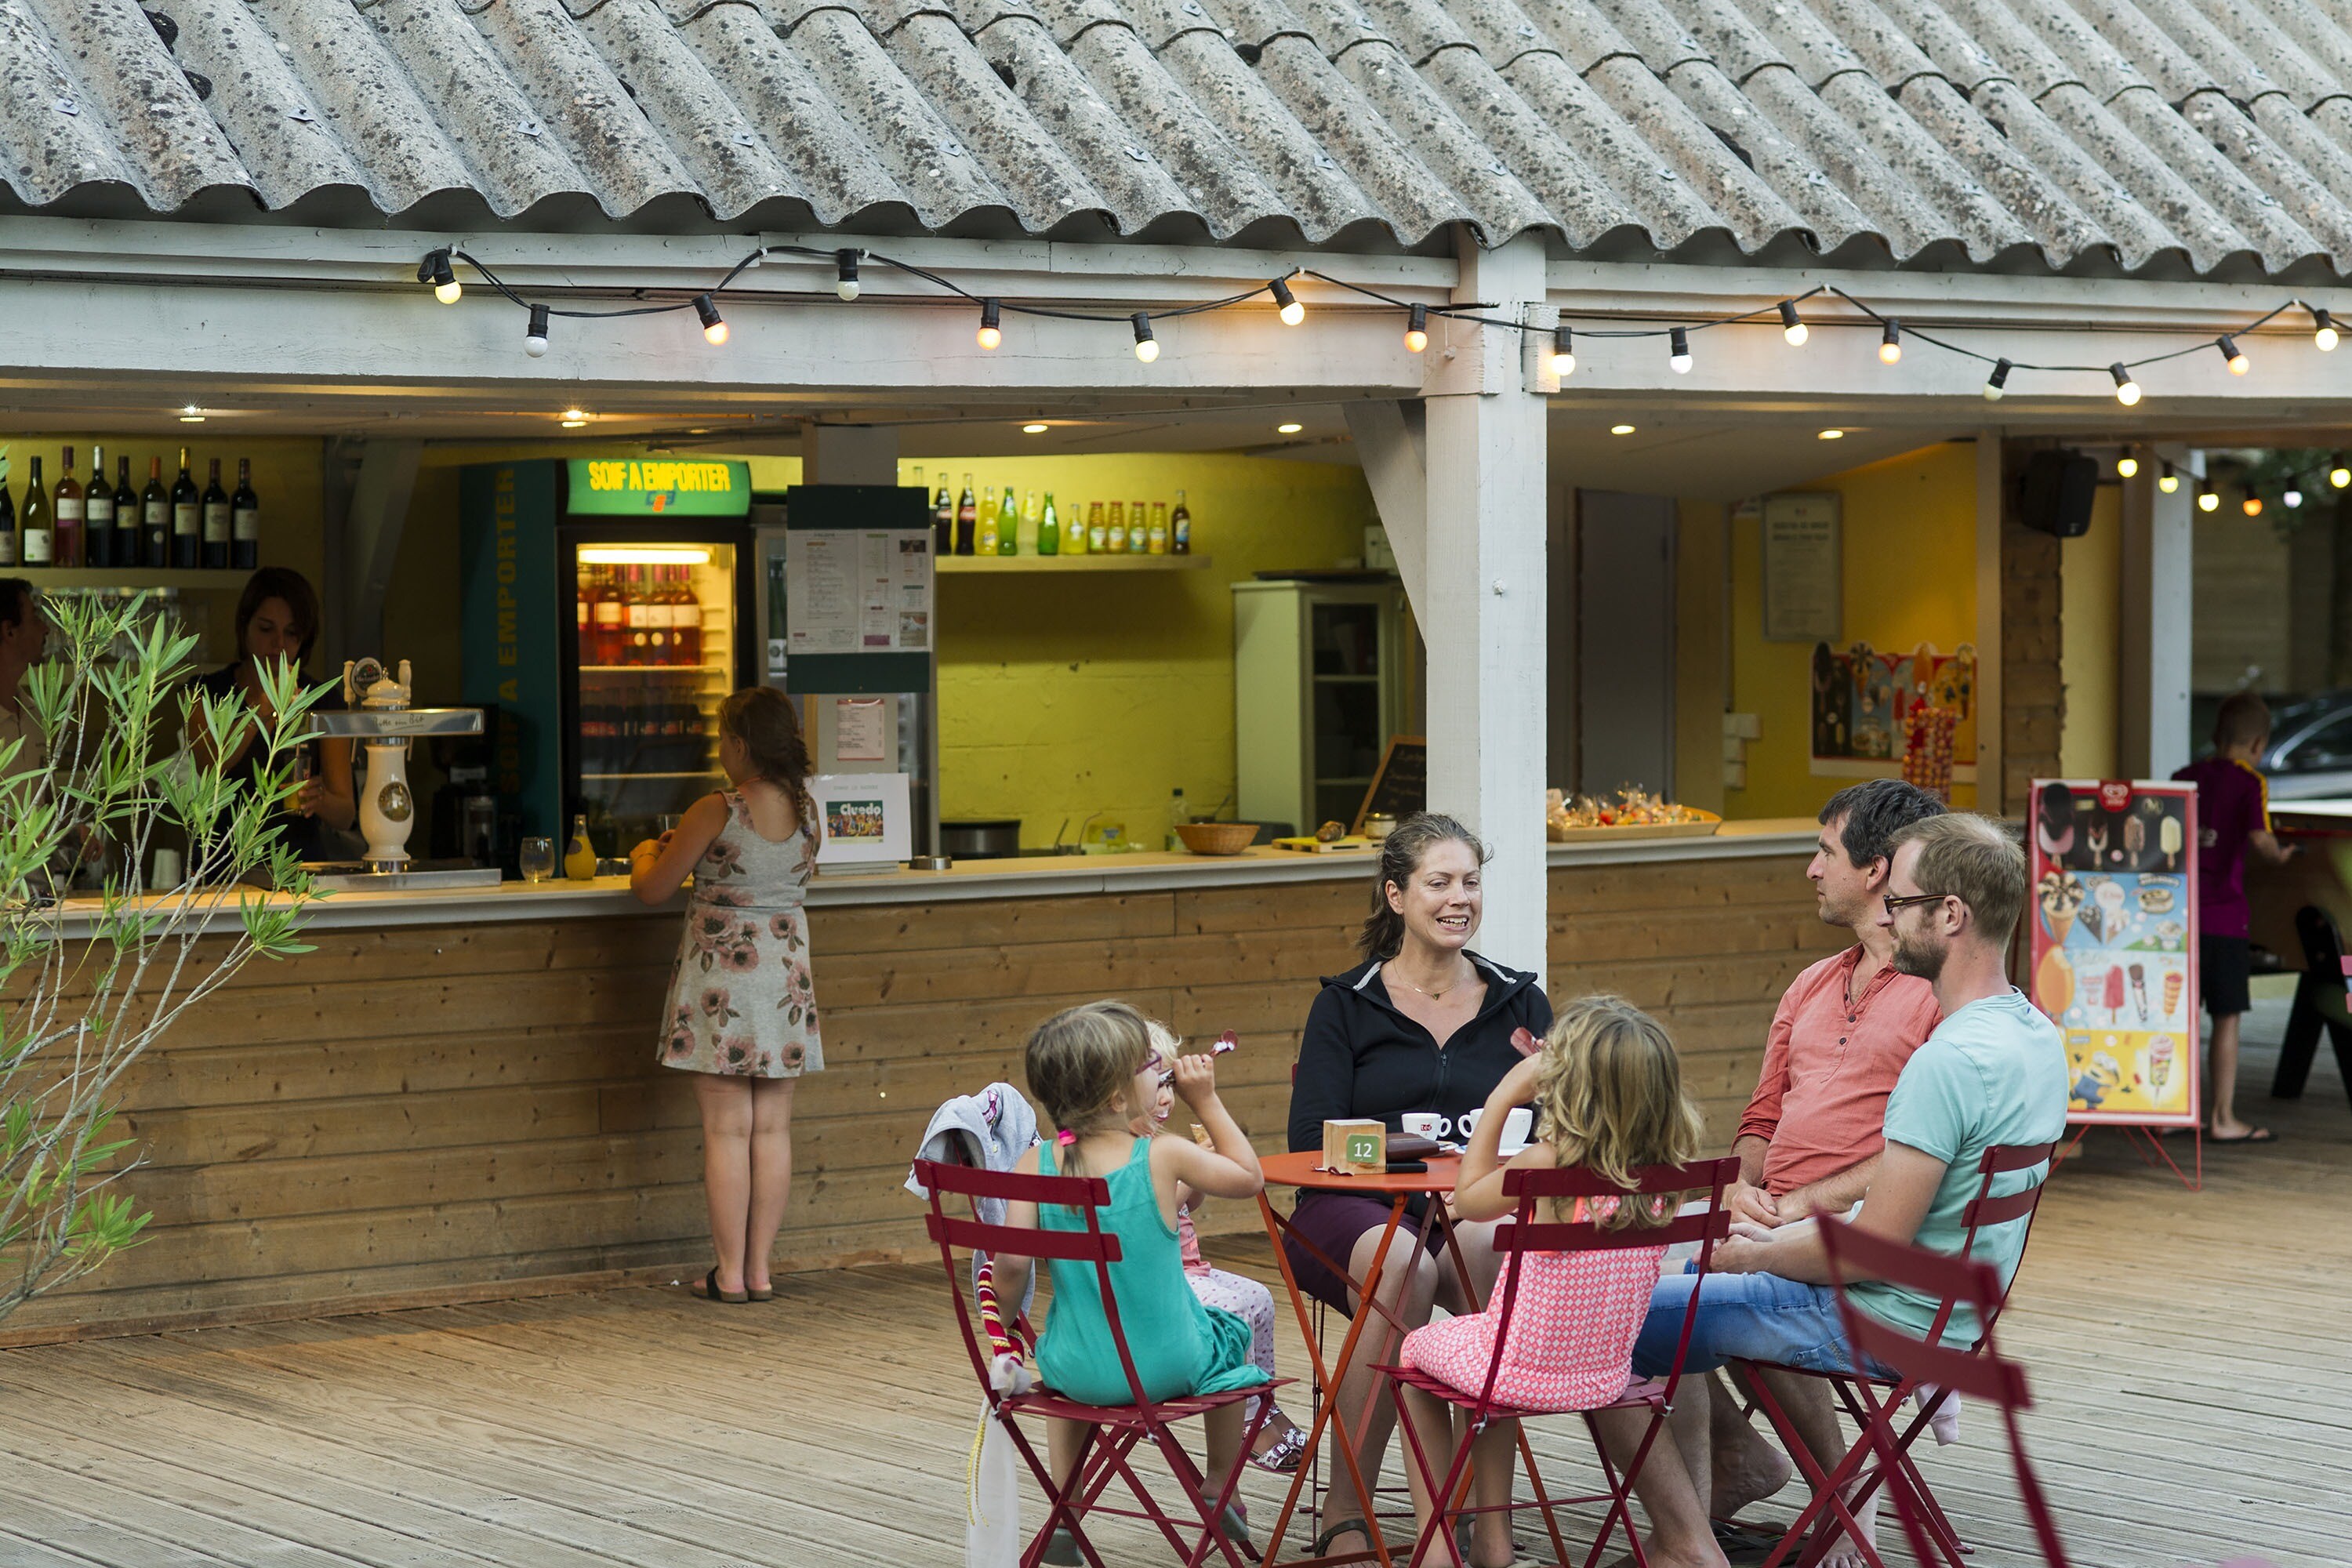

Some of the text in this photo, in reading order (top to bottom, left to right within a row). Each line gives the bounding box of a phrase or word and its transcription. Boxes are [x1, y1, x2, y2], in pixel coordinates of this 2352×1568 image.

[588, 461, 731, 492] SOIF A EMPORTER
[495, 469, 517, 666] EMPORTER
[499, 678, 518, 702] A
[840, 803, 881, 816] Cluedo
[1354, 1142, 1372, 1157] 12
